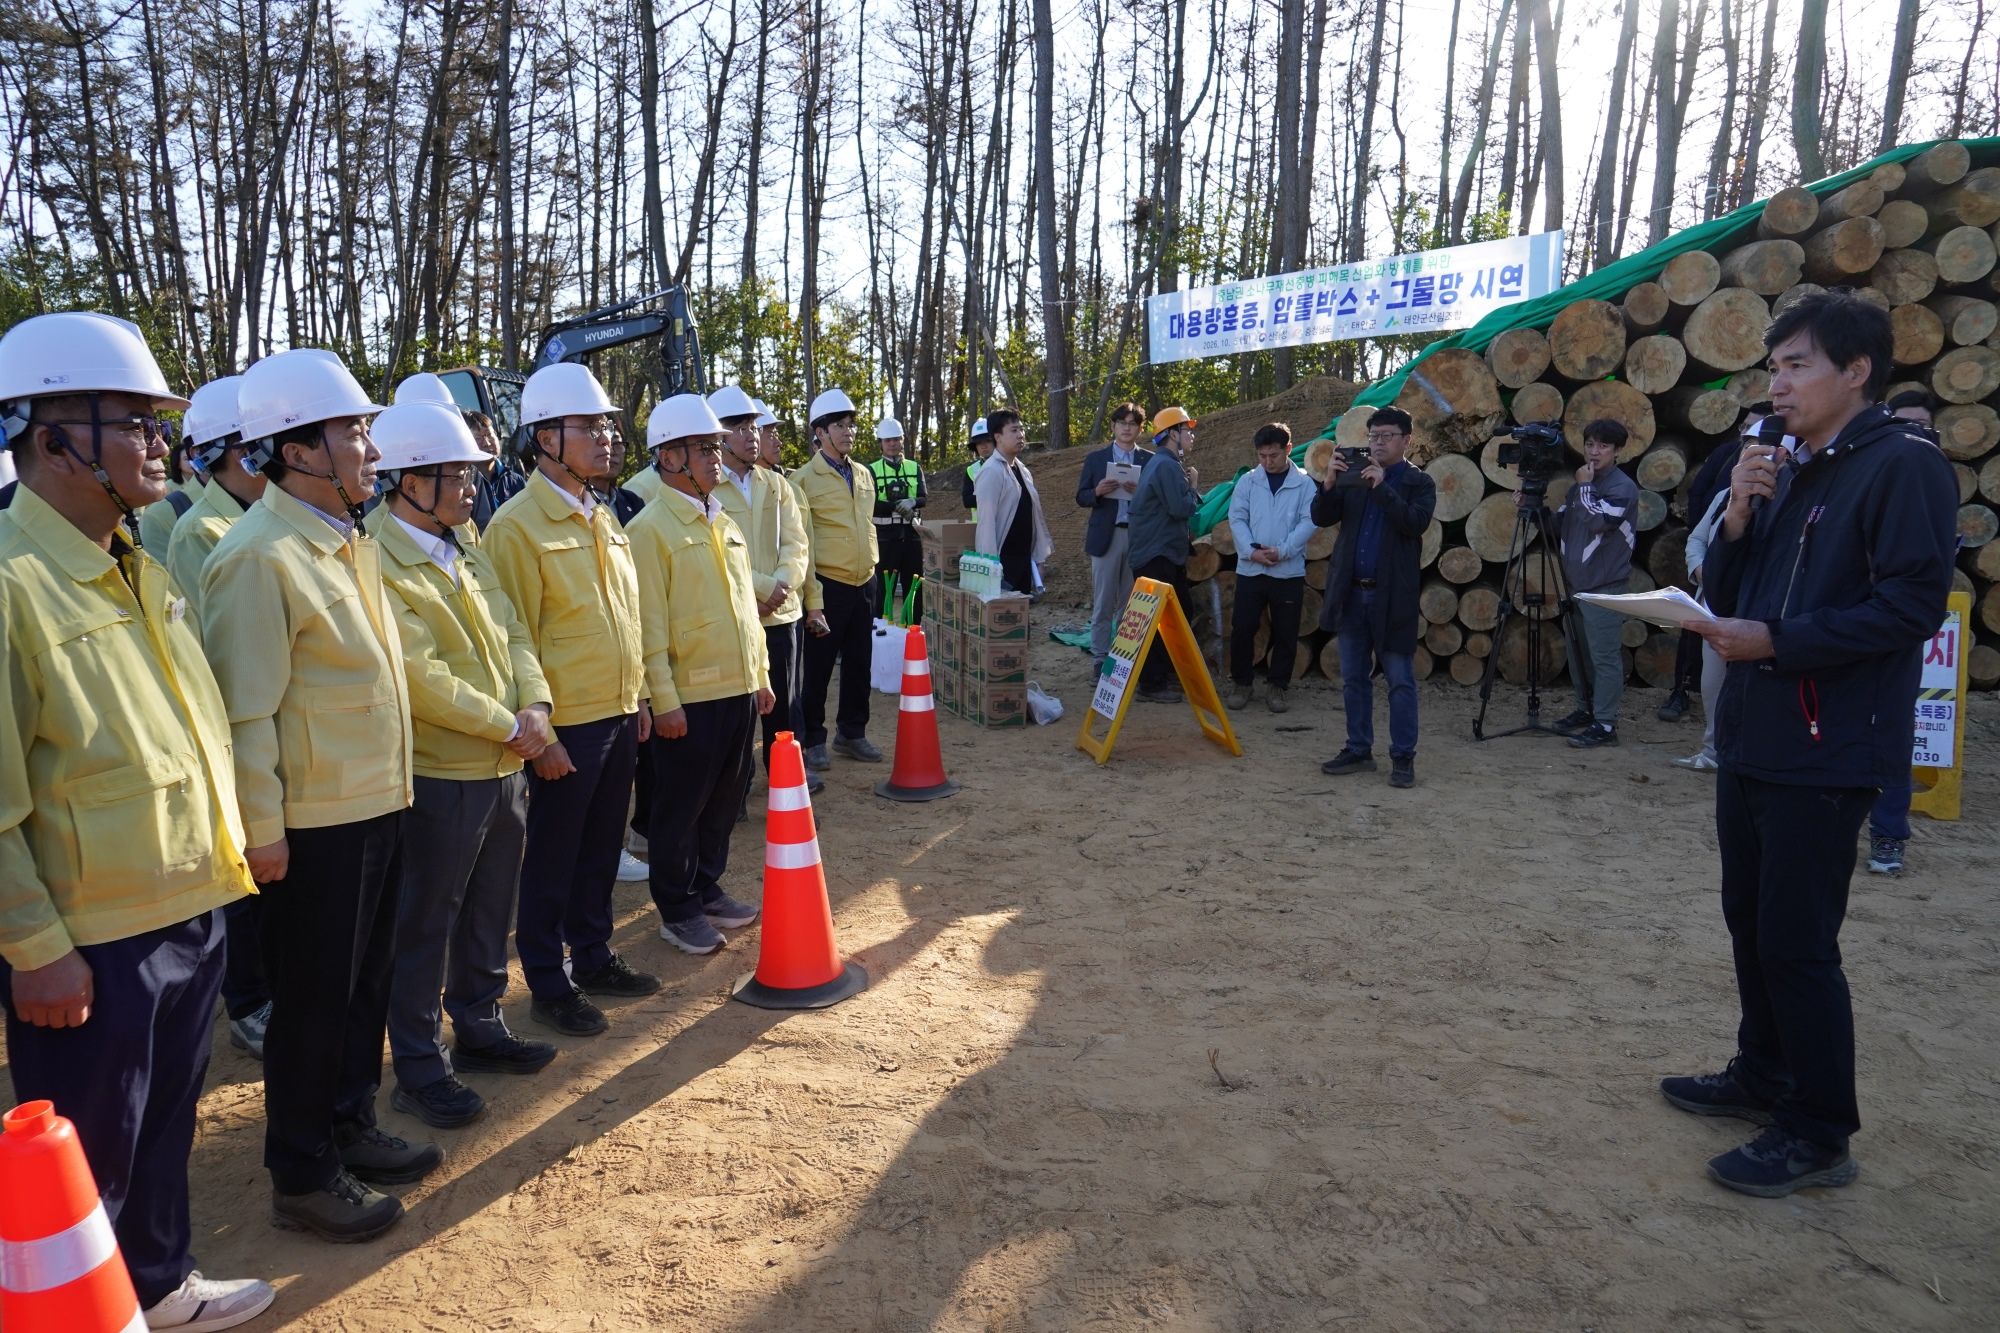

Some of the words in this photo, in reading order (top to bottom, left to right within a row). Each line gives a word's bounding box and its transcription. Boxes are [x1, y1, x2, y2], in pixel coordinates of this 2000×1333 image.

[1217, 286, 1244, 302] 충남권
[1246, 274, 1315, 297] 소나무재선충병
[1318, 269, 1349, 285] 피해목
[1352, 263, 1386, 282] 산업화
[1389, 257, 1424, 277] 방제를
[1427, 253, 1452, 270] 위한
[1169, 301, 1265, 339] 대용량훈증,
[1273, 287, 1358, 325] 암롤박스
[1385, 272, 1464, 310] 그물망
[1469, 264, 1524, 299] 시연
[1351, 319, 1377, 330] 태안군
[1404, 311, 1462, 325] 태안군산림조합
[584, 326, 624, 343] HYUNDAI
[1924, 629, 1955, 668] 지
[1914, 751, 1940, 762] 030
